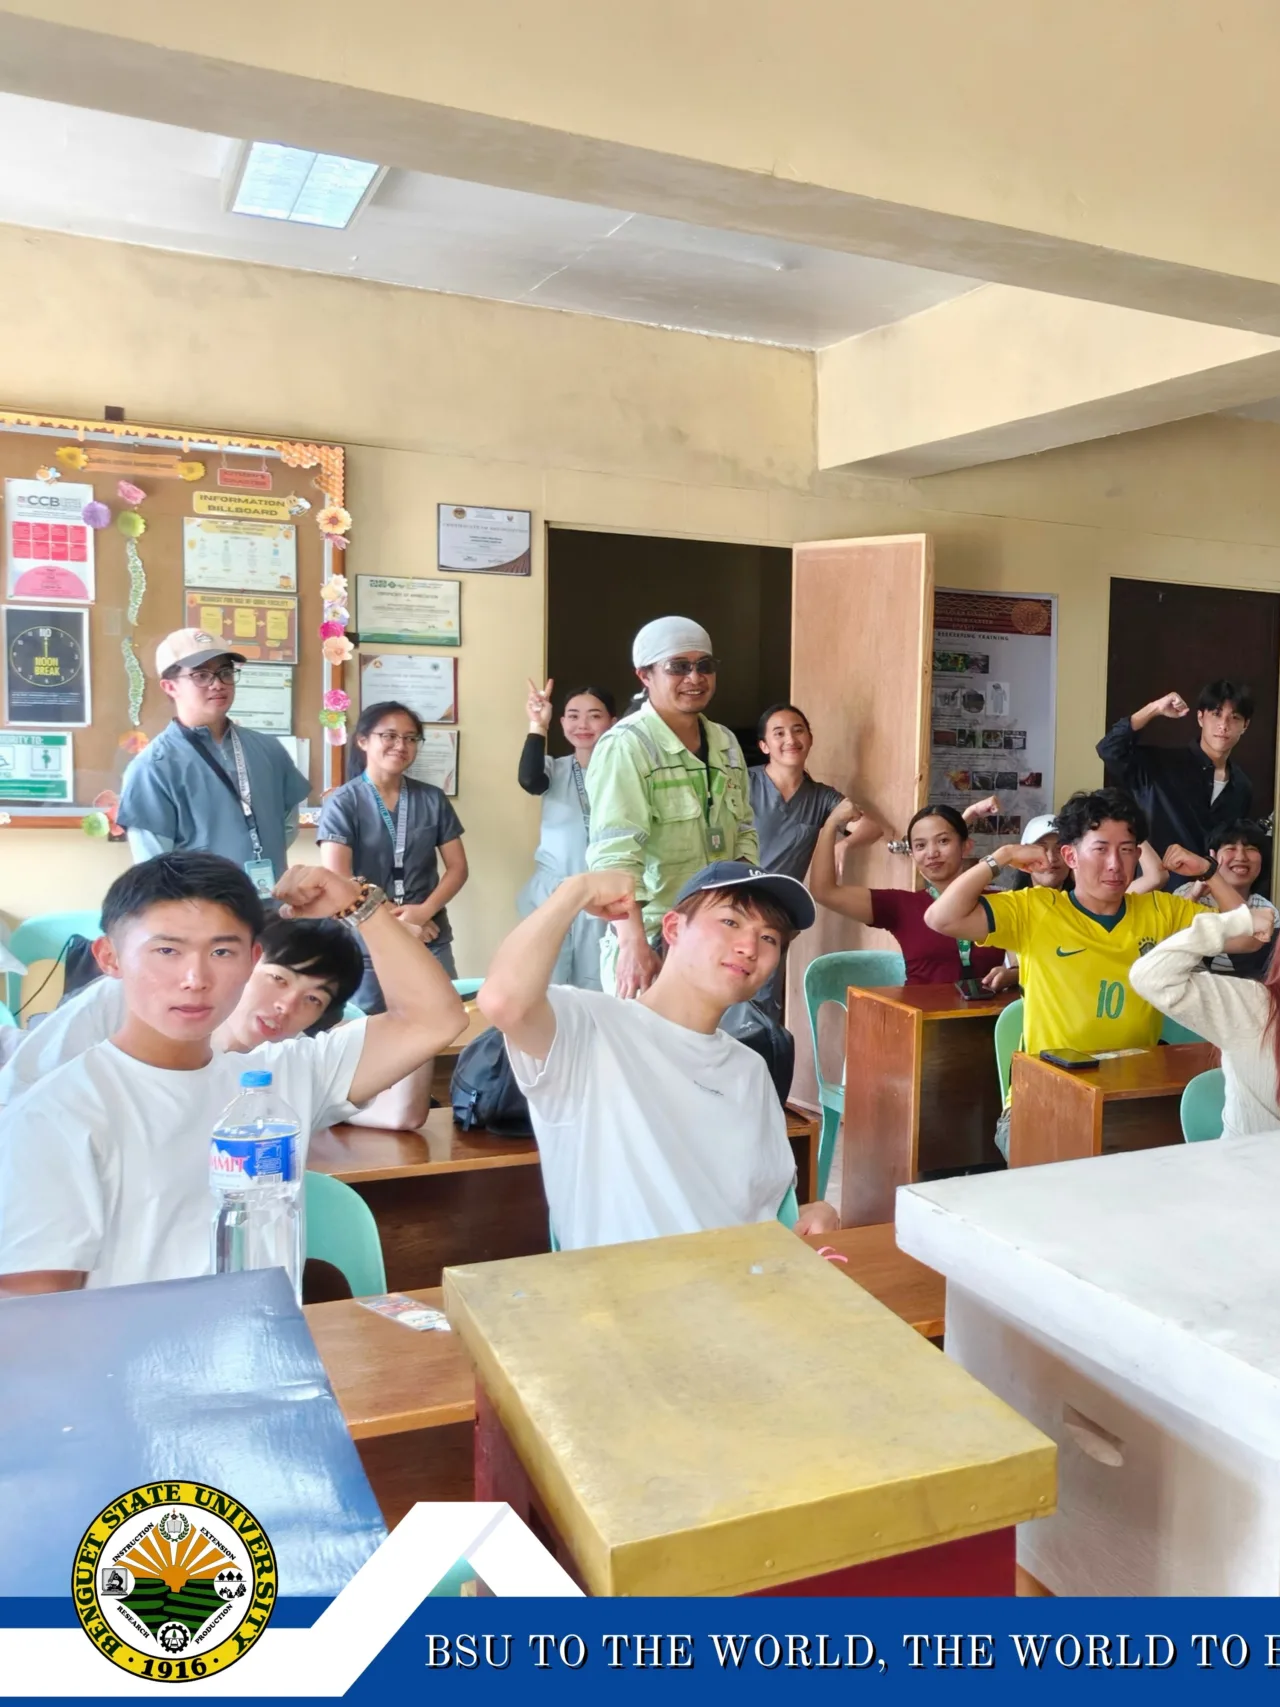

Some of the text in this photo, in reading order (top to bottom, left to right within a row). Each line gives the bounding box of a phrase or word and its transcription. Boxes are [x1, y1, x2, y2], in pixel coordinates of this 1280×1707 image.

[27, 495, 60, 507] CCB
[200, 494, 285, 507] INFORMATION
[207, 505, 278, 516] BILLBOARD
[39, 628, 52, 638] NO
[937, 631, 976, 639] BEEKEEPING
[34, 656, 59, 667] NOON
[34, 666, 61, 676] BREAK
[1096, 979, 1125, 1020] 10
